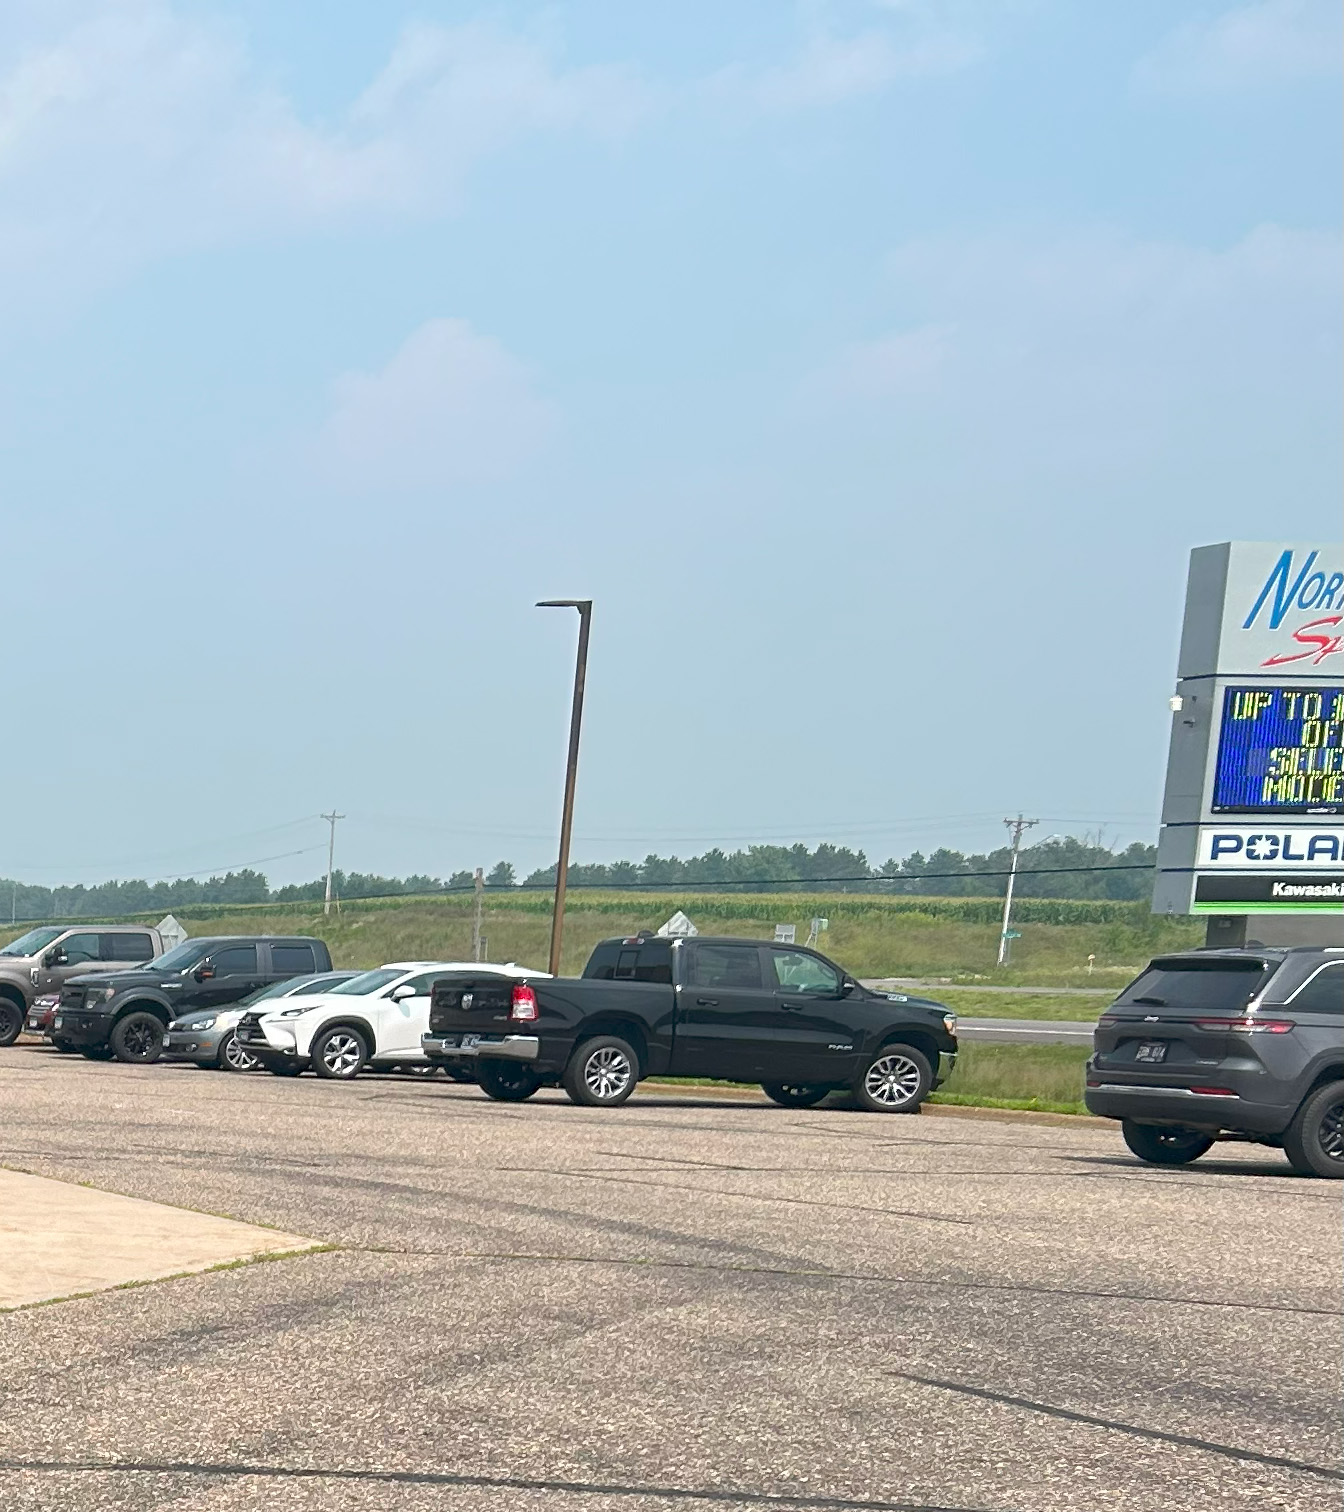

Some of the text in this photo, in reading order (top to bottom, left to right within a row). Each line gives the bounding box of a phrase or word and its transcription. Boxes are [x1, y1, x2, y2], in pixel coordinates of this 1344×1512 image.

[1241, 549, 1344, 630] NOR
[1234, 692, 1273, 720] UP
[1283, 692, 1322, 721] TO
[1301, 720, 1344, 748] OF
[1269, 747, 1344, 775] SELE
[1210, 834, 1344, 861] POLA
